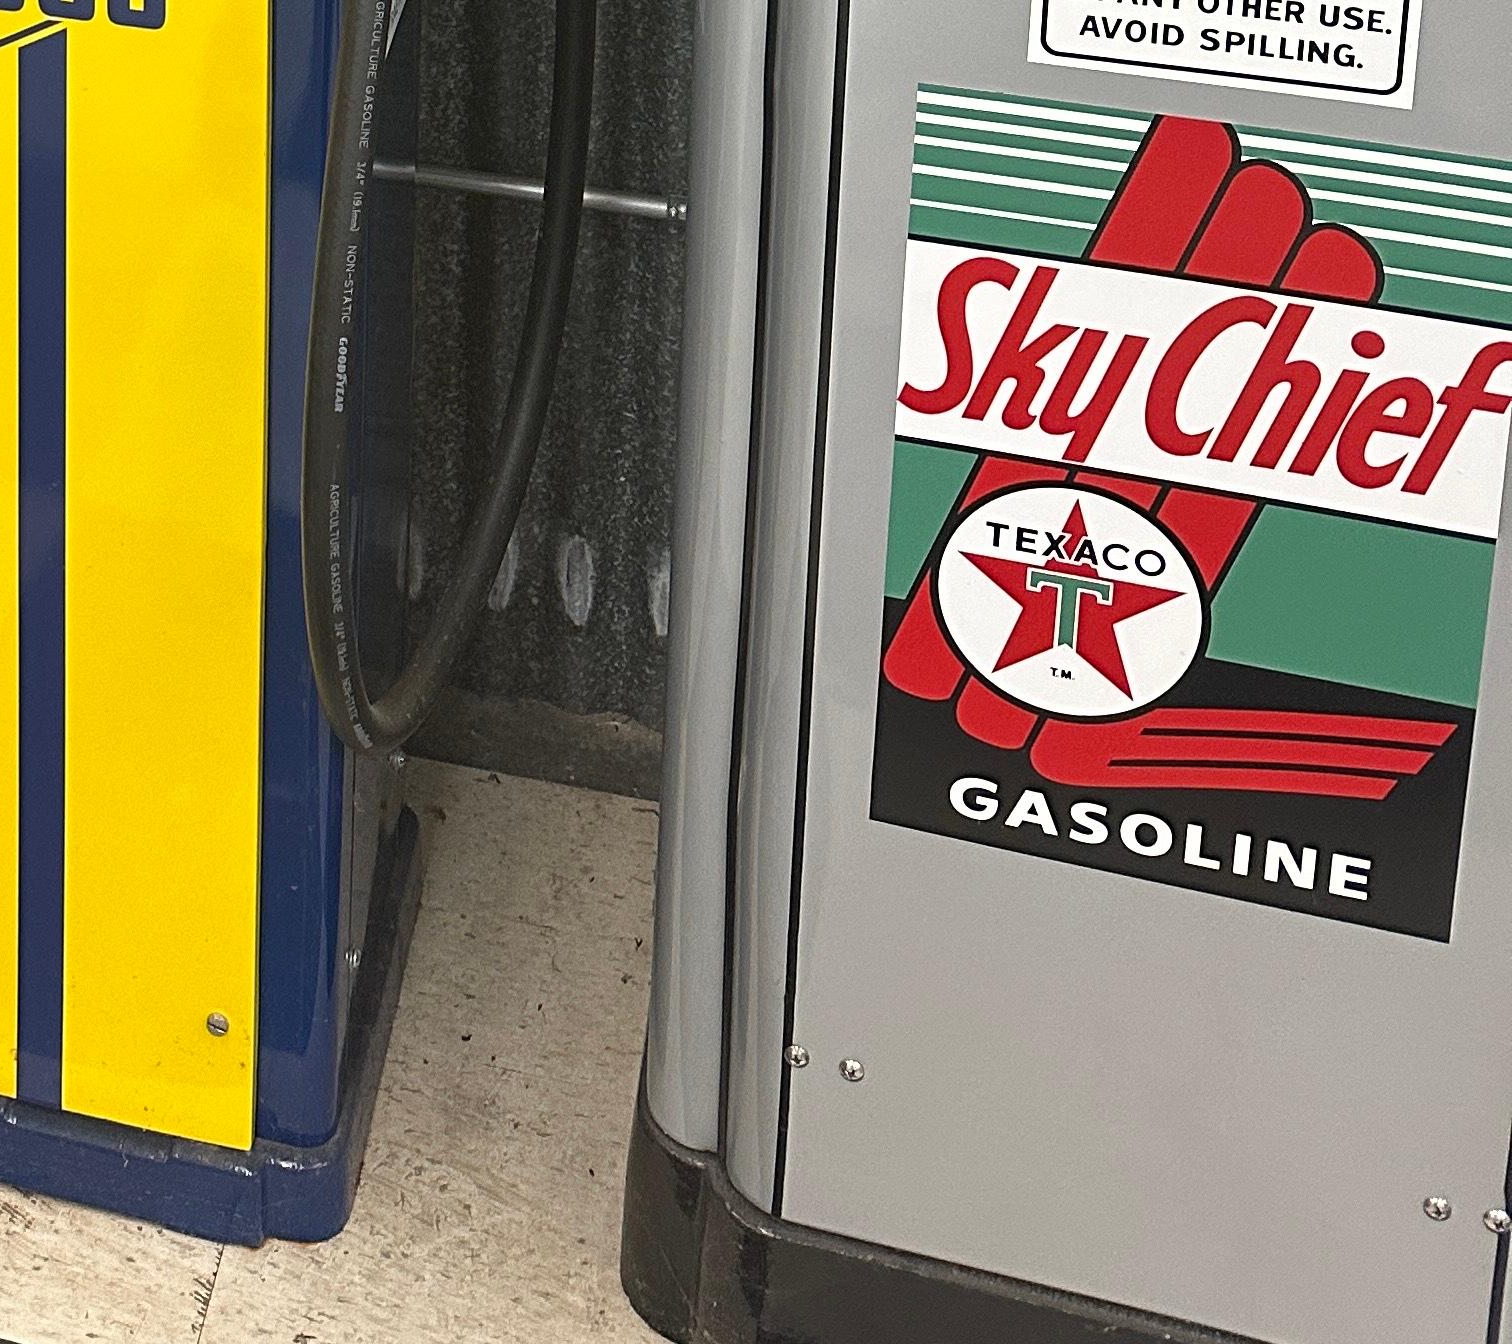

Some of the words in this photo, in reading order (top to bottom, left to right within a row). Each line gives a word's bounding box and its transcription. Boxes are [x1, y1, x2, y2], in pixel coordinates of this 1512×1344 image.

[1079, 15, 1185, 46] AVOID
[1200, 29, 1364, 70] SPILLING.
[1319, 3, 1393, 35] USE.
[359, 85, 376, 149] GASOLINE
[341, 245, 358, 324] NON-STATIC
[334, 337, 348, 413] GOODYEAR
[897, 257, 1149, 463] Sky
[1144, 296, 1512, 495] Chief
[329, 484, 340, 561] AGRICULTURE
[986, 521, 1166, 576] TEXACO
[331, 563, 343, 613] GASOLINE
[1026, 567, 1114, 649] T
[1050, 667, 1075, 680] T.M.
[948, 777, 1373, 901] GASOLINE
